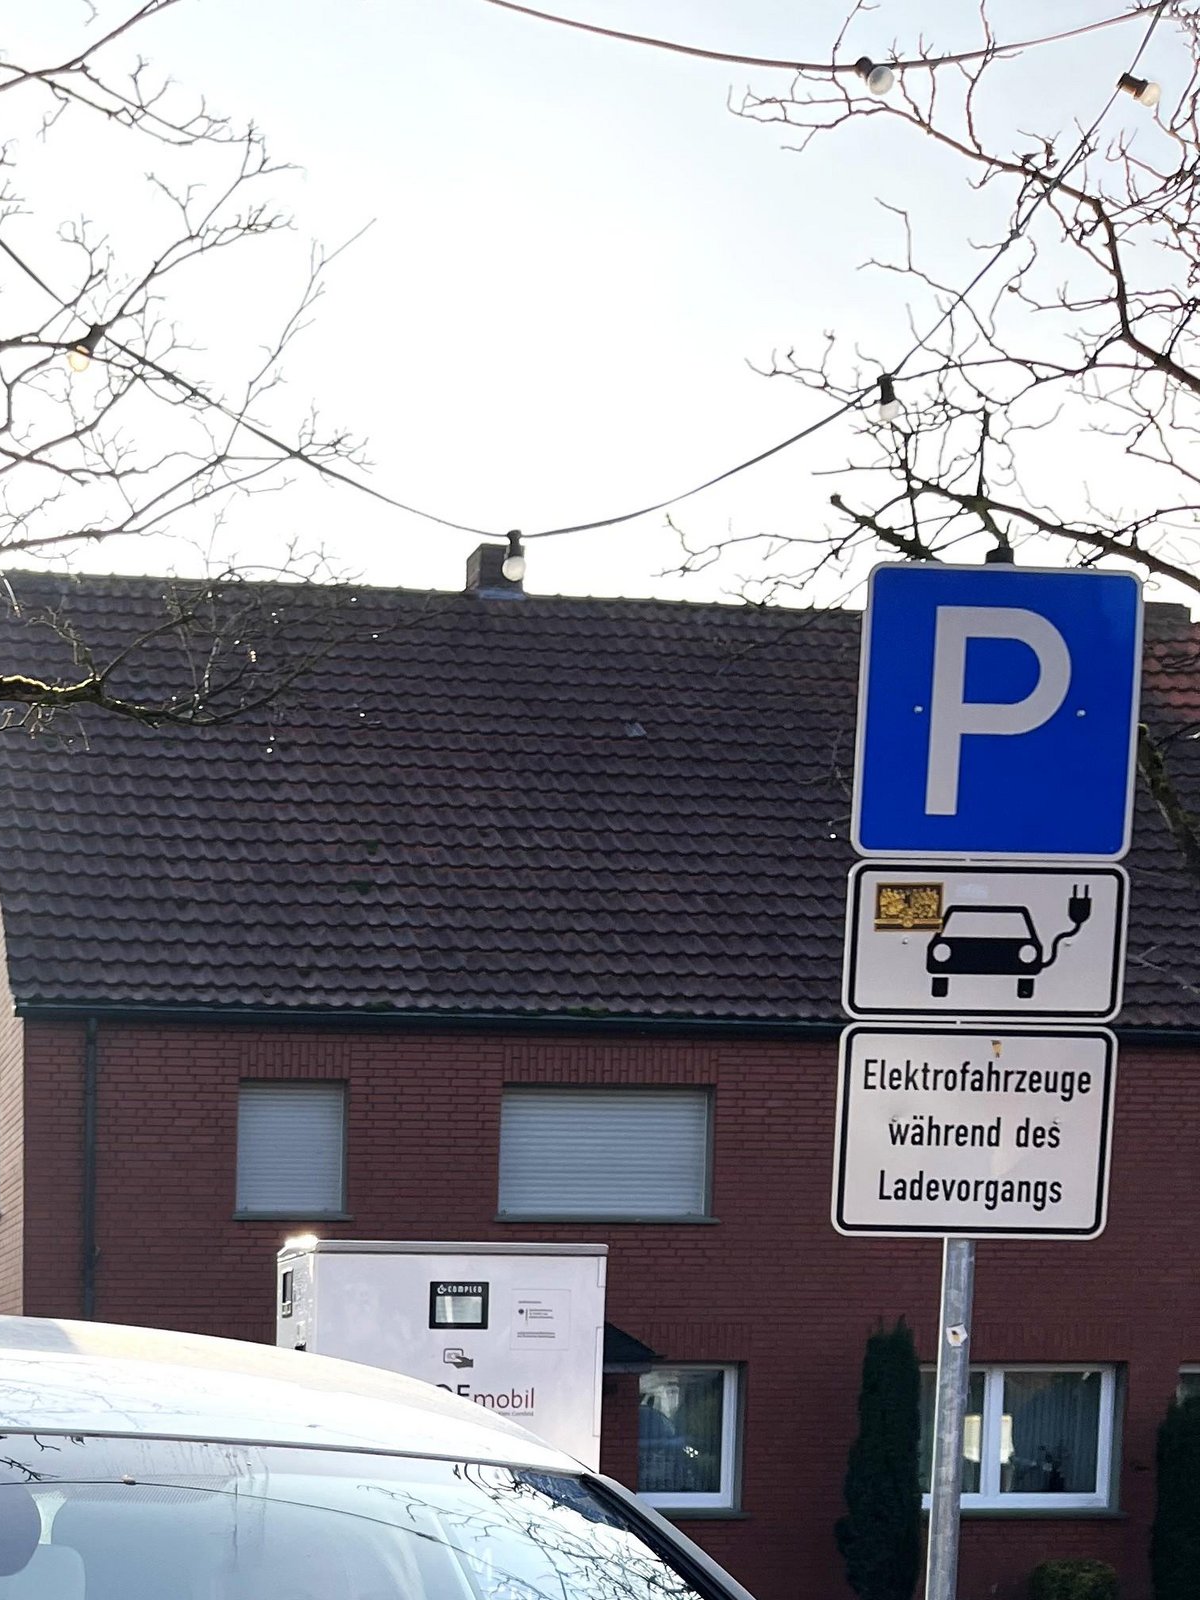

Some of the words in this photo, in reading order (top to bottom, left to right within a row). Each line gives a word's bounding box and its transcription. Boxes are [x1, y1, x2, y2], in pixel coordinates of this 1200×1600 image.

[925, 606, 1071, 815] P
[863, 1058, 1092, 1102] Elektrofahrzeuge
[888, 1115, 1001, 1147] während
[1015, 1117, 1061, 1148] des
[878, 1169, 1062, 1211] Ladevorgangs
